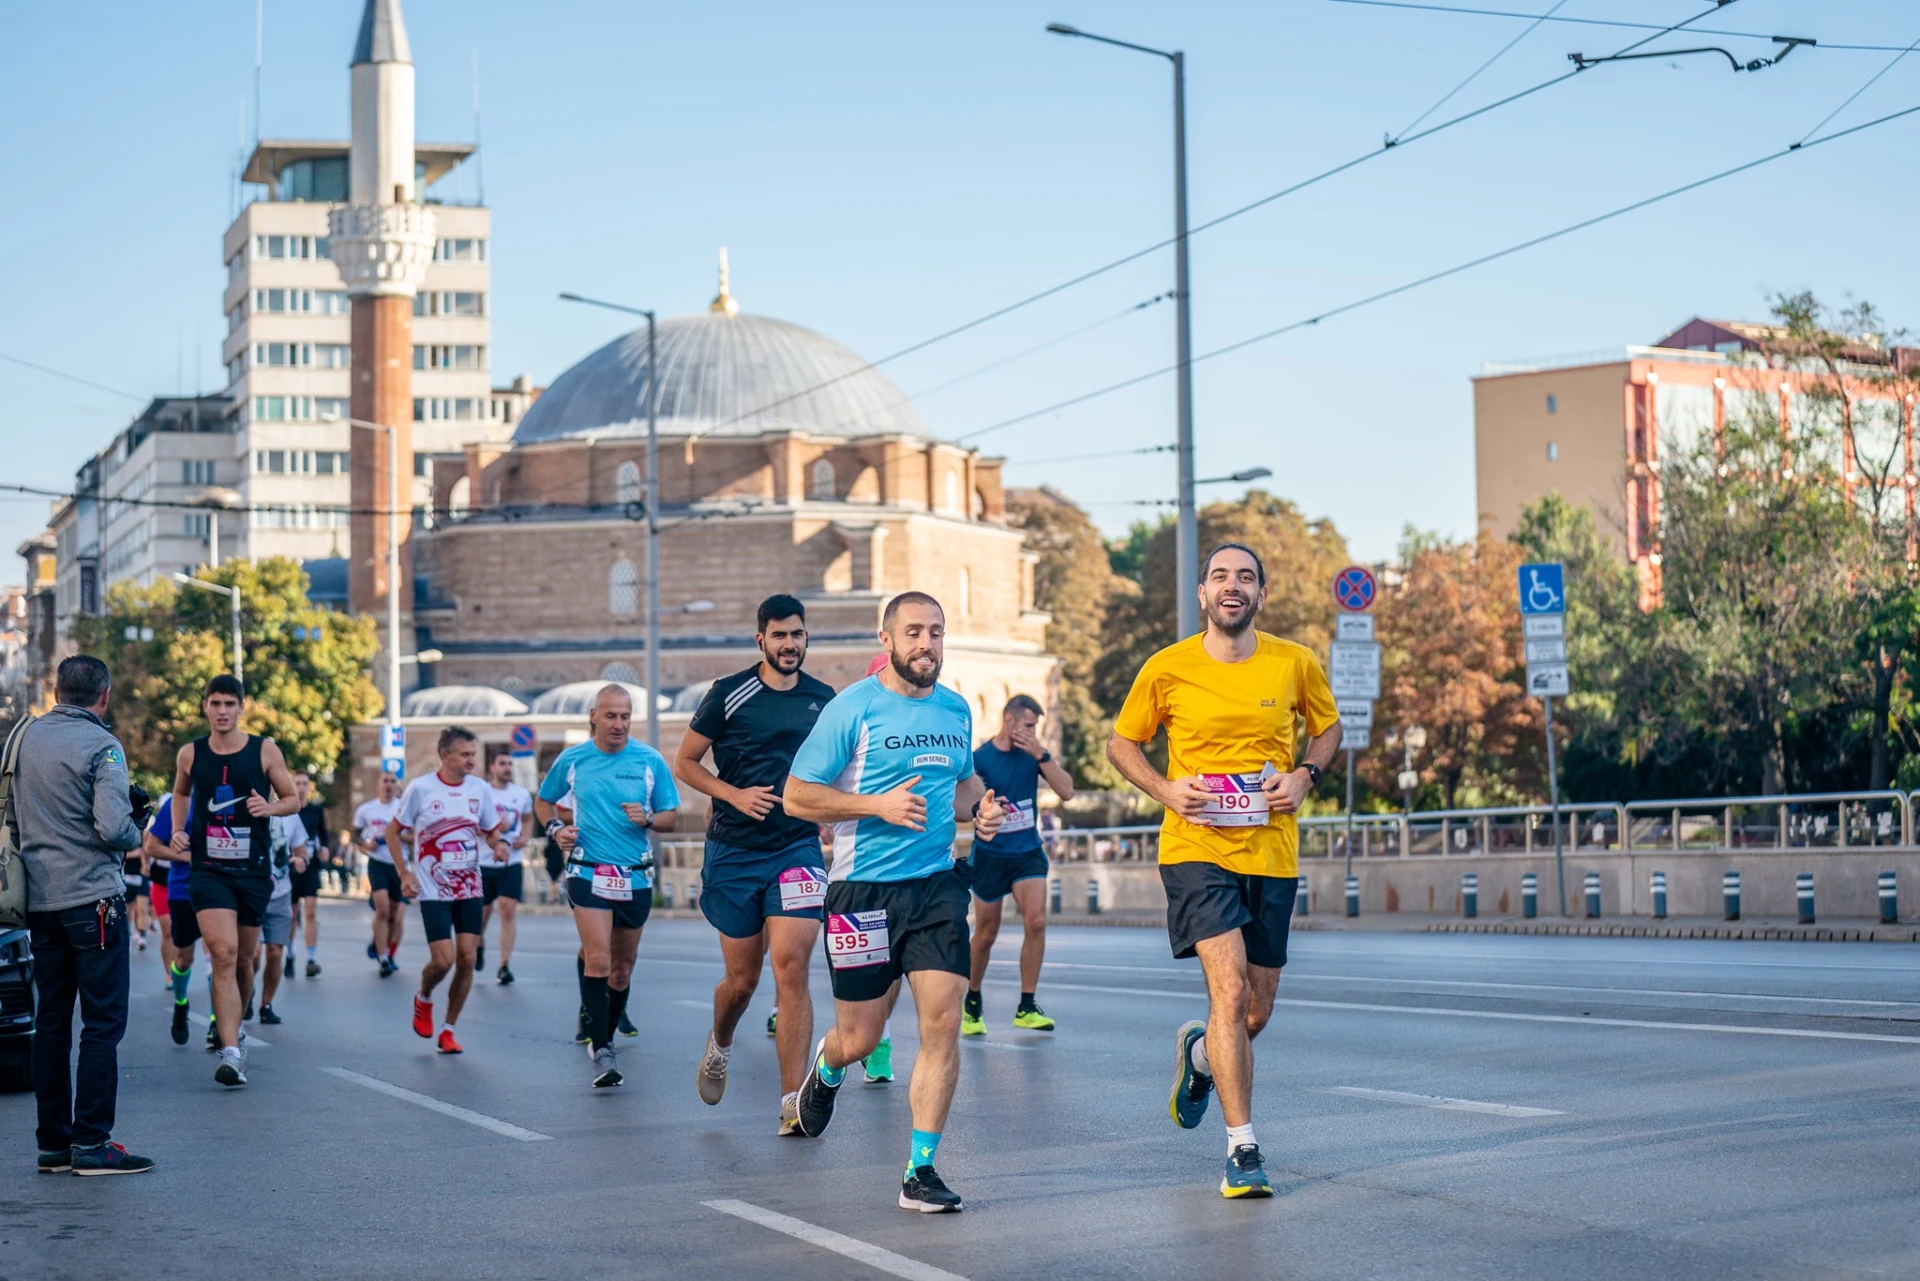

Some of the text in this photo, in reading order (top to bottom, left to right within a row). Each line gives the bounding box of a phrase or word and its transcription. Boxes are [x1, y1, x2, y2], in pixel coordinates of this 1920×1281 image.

[884, 734, 966, 750] GARMIN
[916, 755, 947, 764] RUN SERIES
[615, 773, 644, 781] GARMIN
[1219, 794, 1250, 809] 190
[1006, 811, 1025, 822] 409
[217, 839, 238, 848] 274
[606, 878, 626, 888] 219
[798, 882, 821, 894] 187
[835, 933, 869, 950] 595
